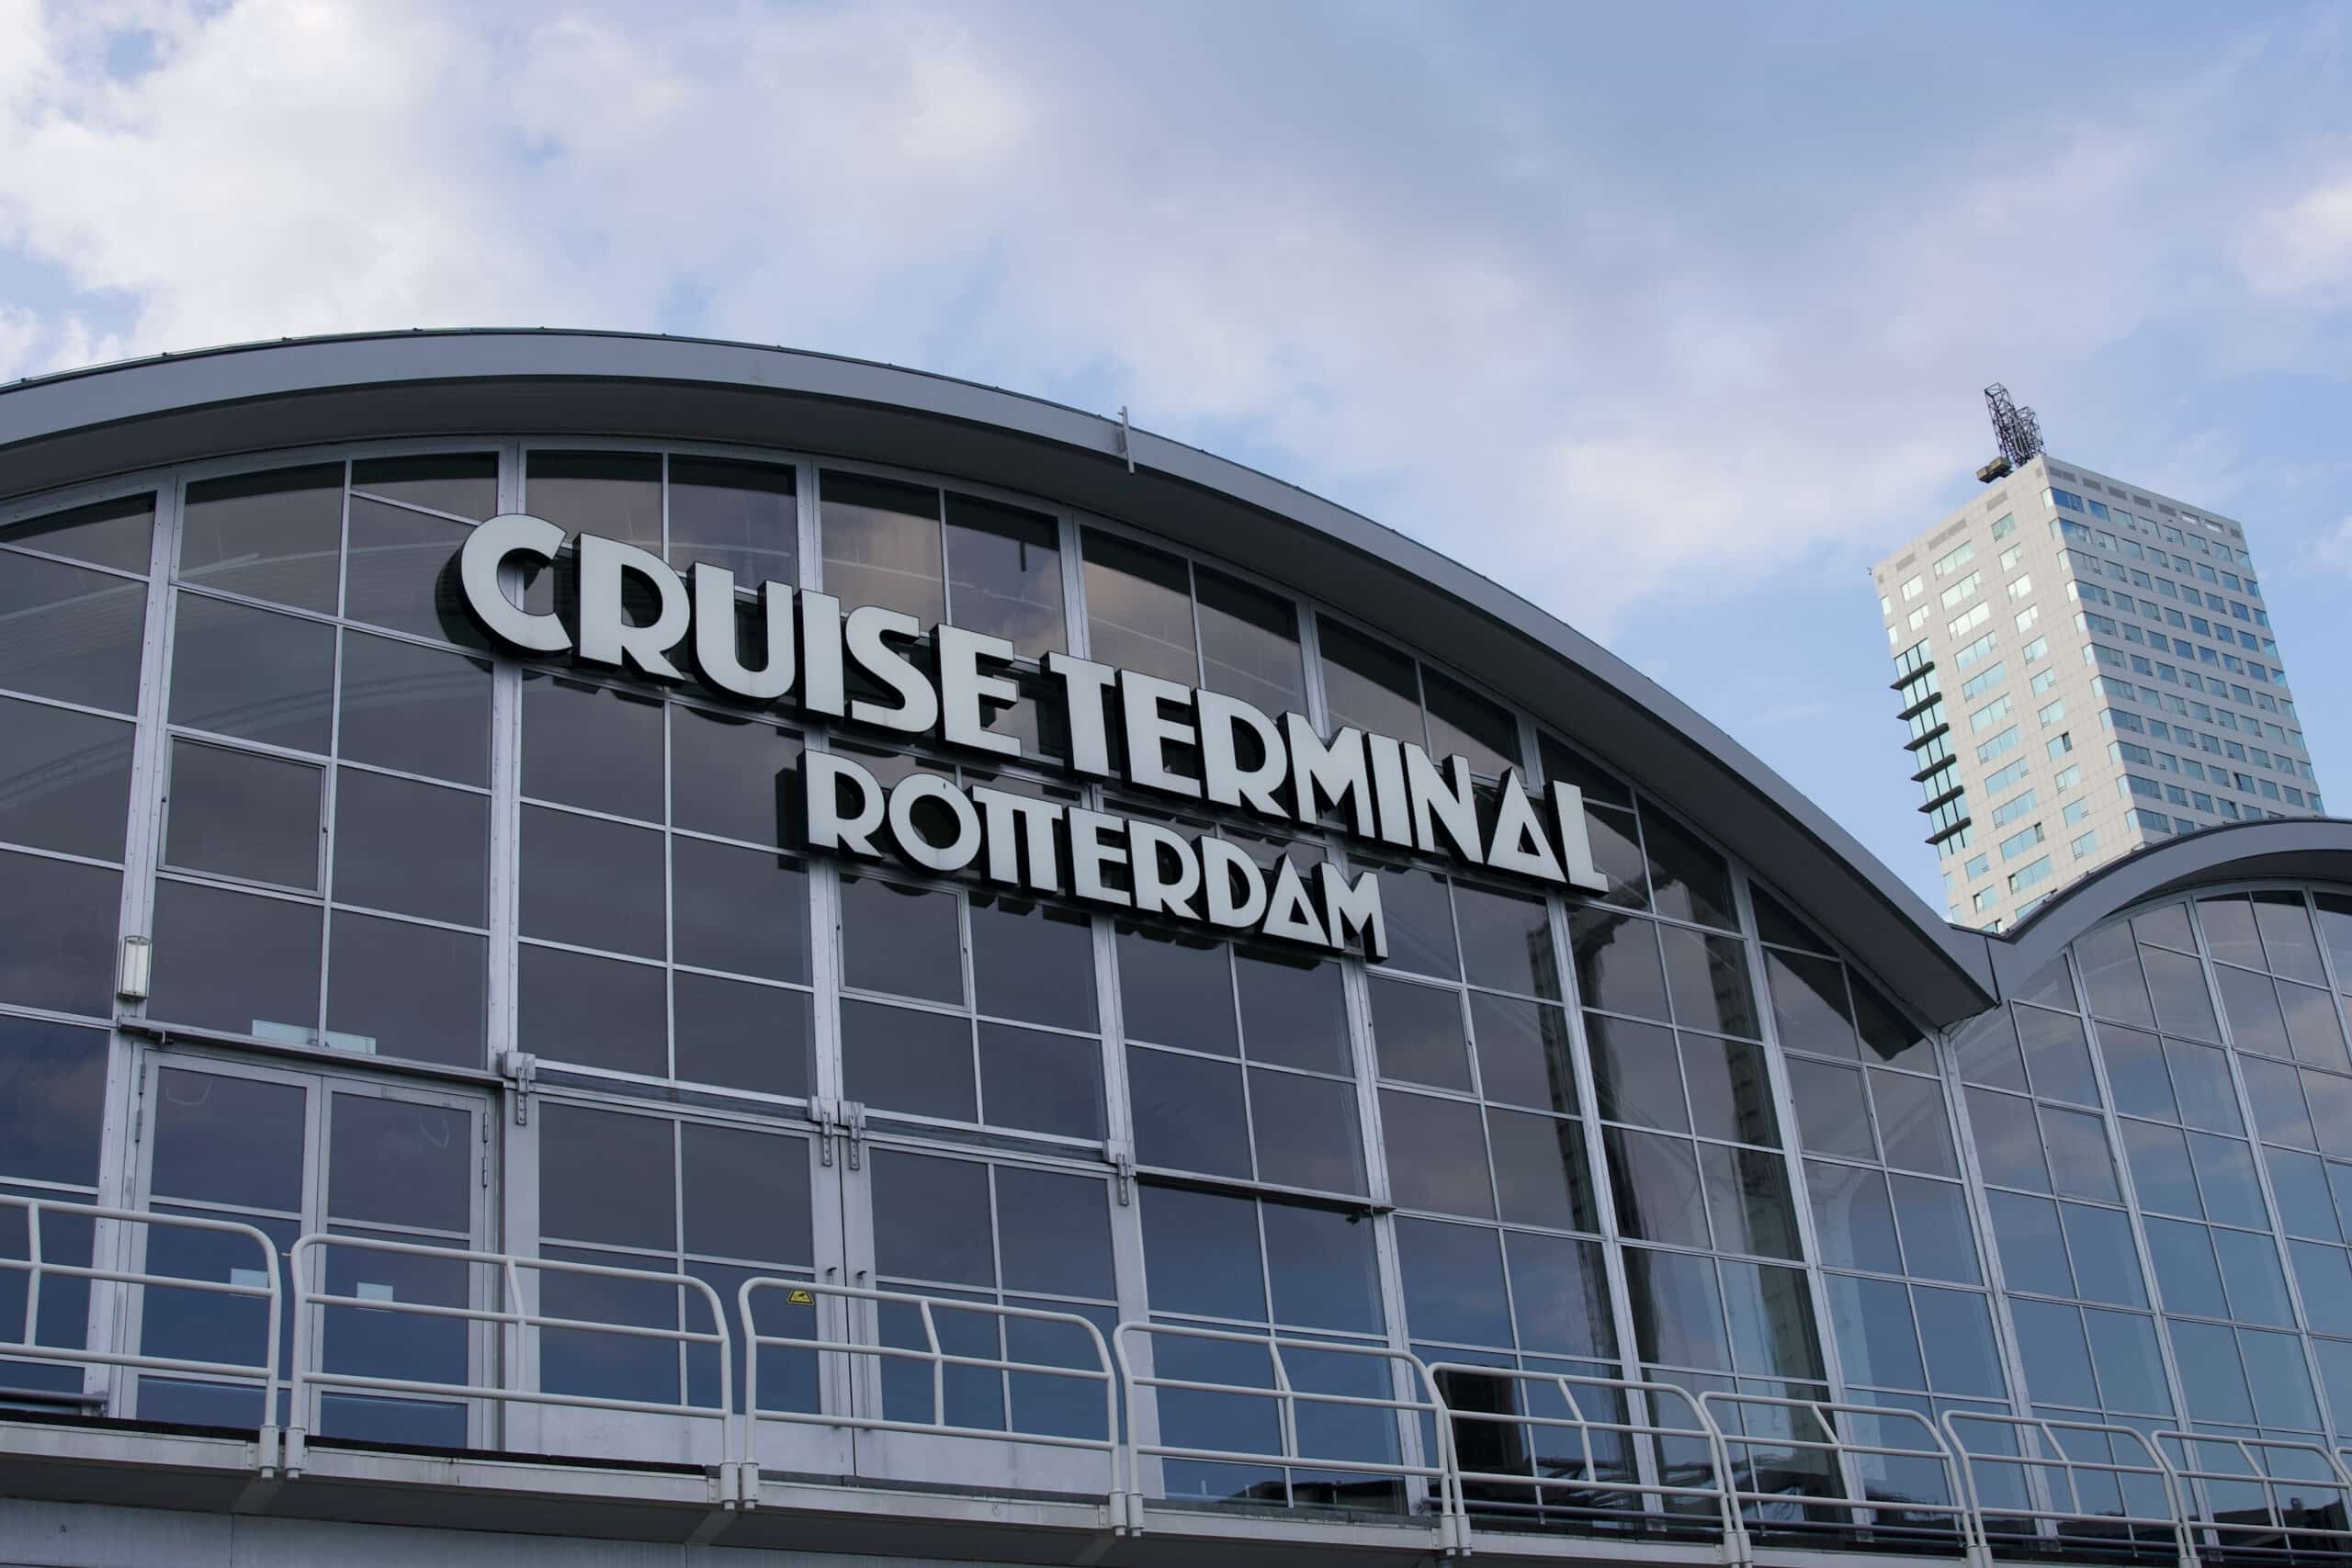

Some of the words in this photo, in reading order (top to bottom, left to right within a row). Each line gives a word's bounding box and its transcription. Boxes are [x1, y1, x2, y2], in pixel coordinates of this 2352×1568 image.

[461, 513, 1022, 757] CRUISE
[1048, 650, 1609, 895] TERMINAL
[805, 749, 1388, 961] ROTTERDAM
